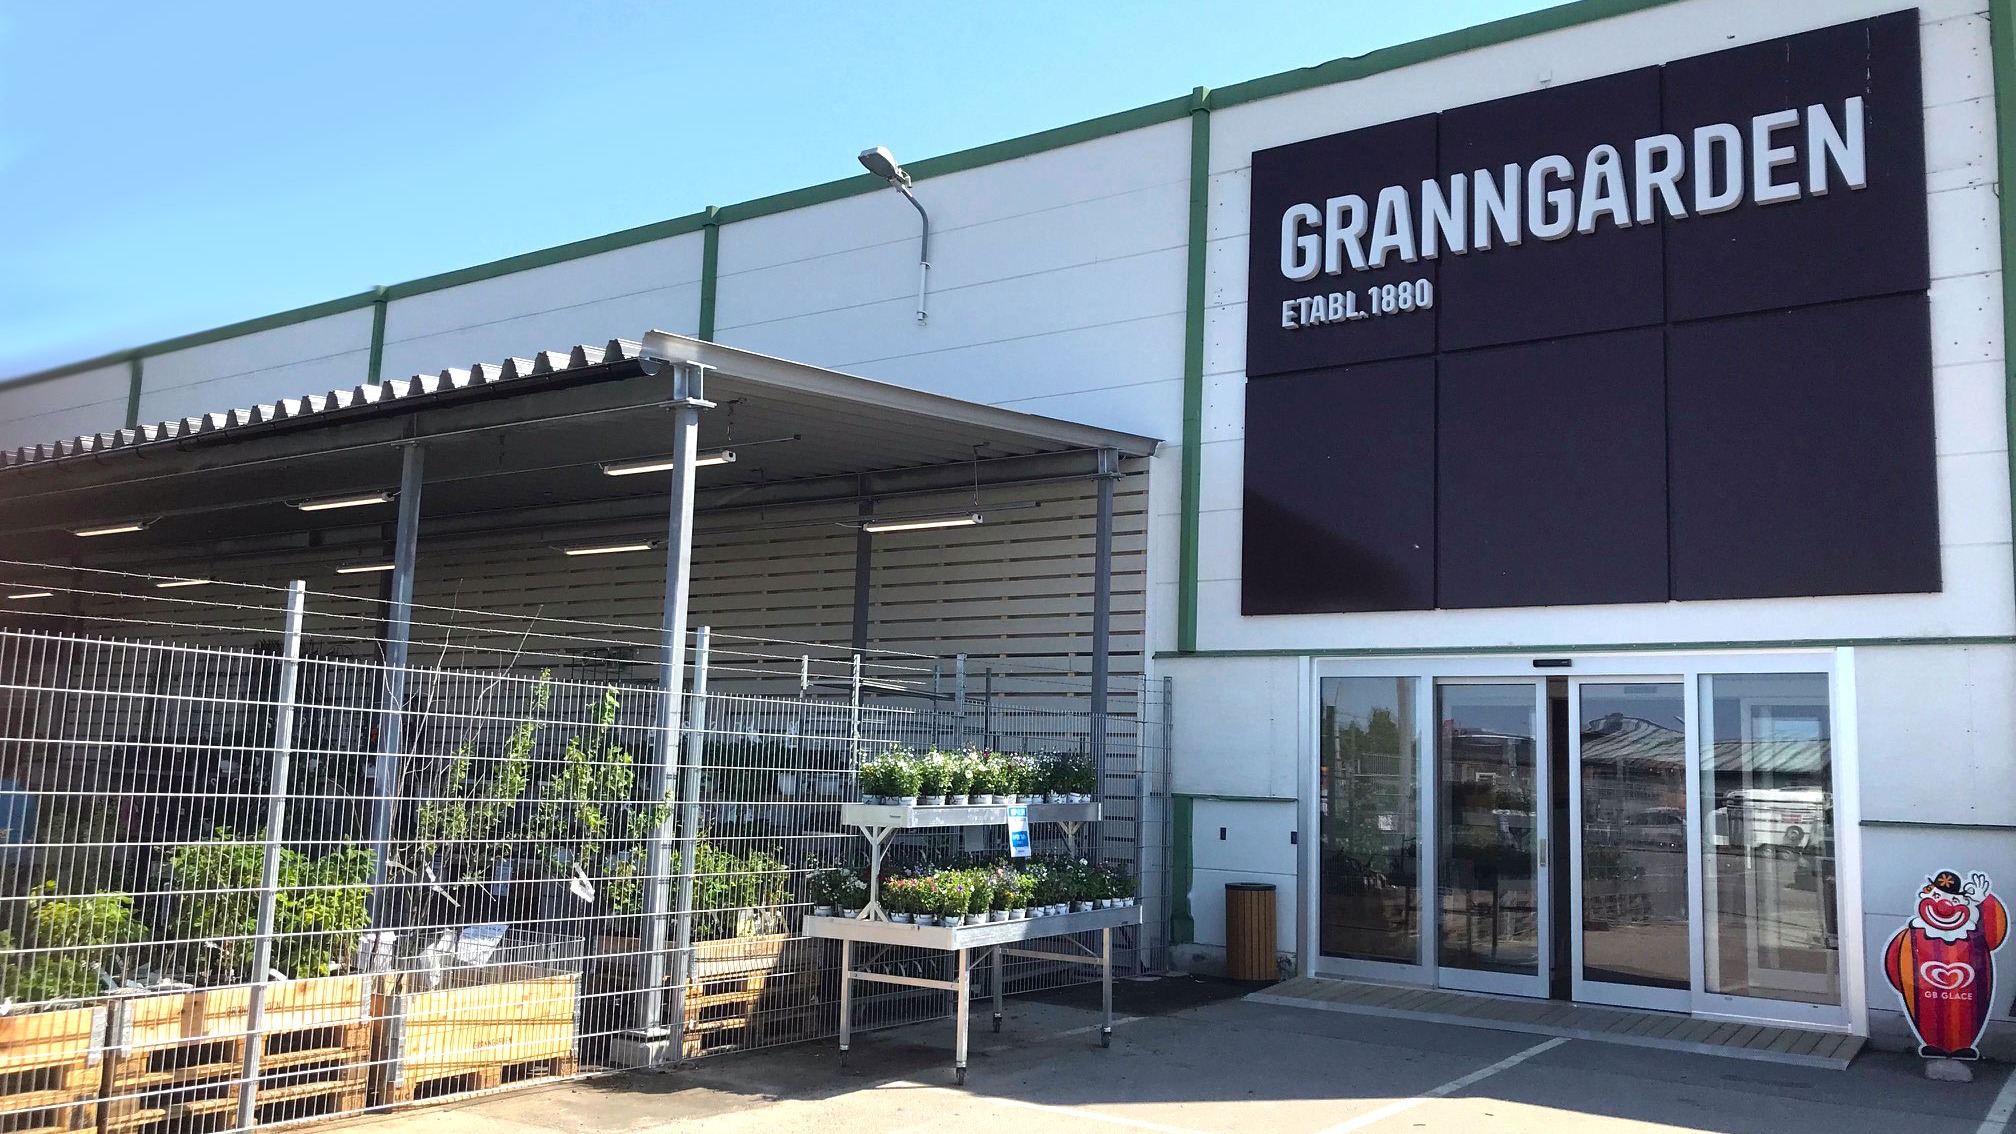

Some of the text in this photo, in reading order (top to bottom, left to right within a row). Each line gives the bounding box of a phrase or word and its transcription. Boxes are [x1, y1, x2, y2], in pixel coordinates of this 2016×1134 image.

[1280, 96, 1867, 282] GRANNGÅRDEN
[1281, 278, 1434, 330] ETABL. 1880
[1924, 990, 1973, 1000] GB GLACE
